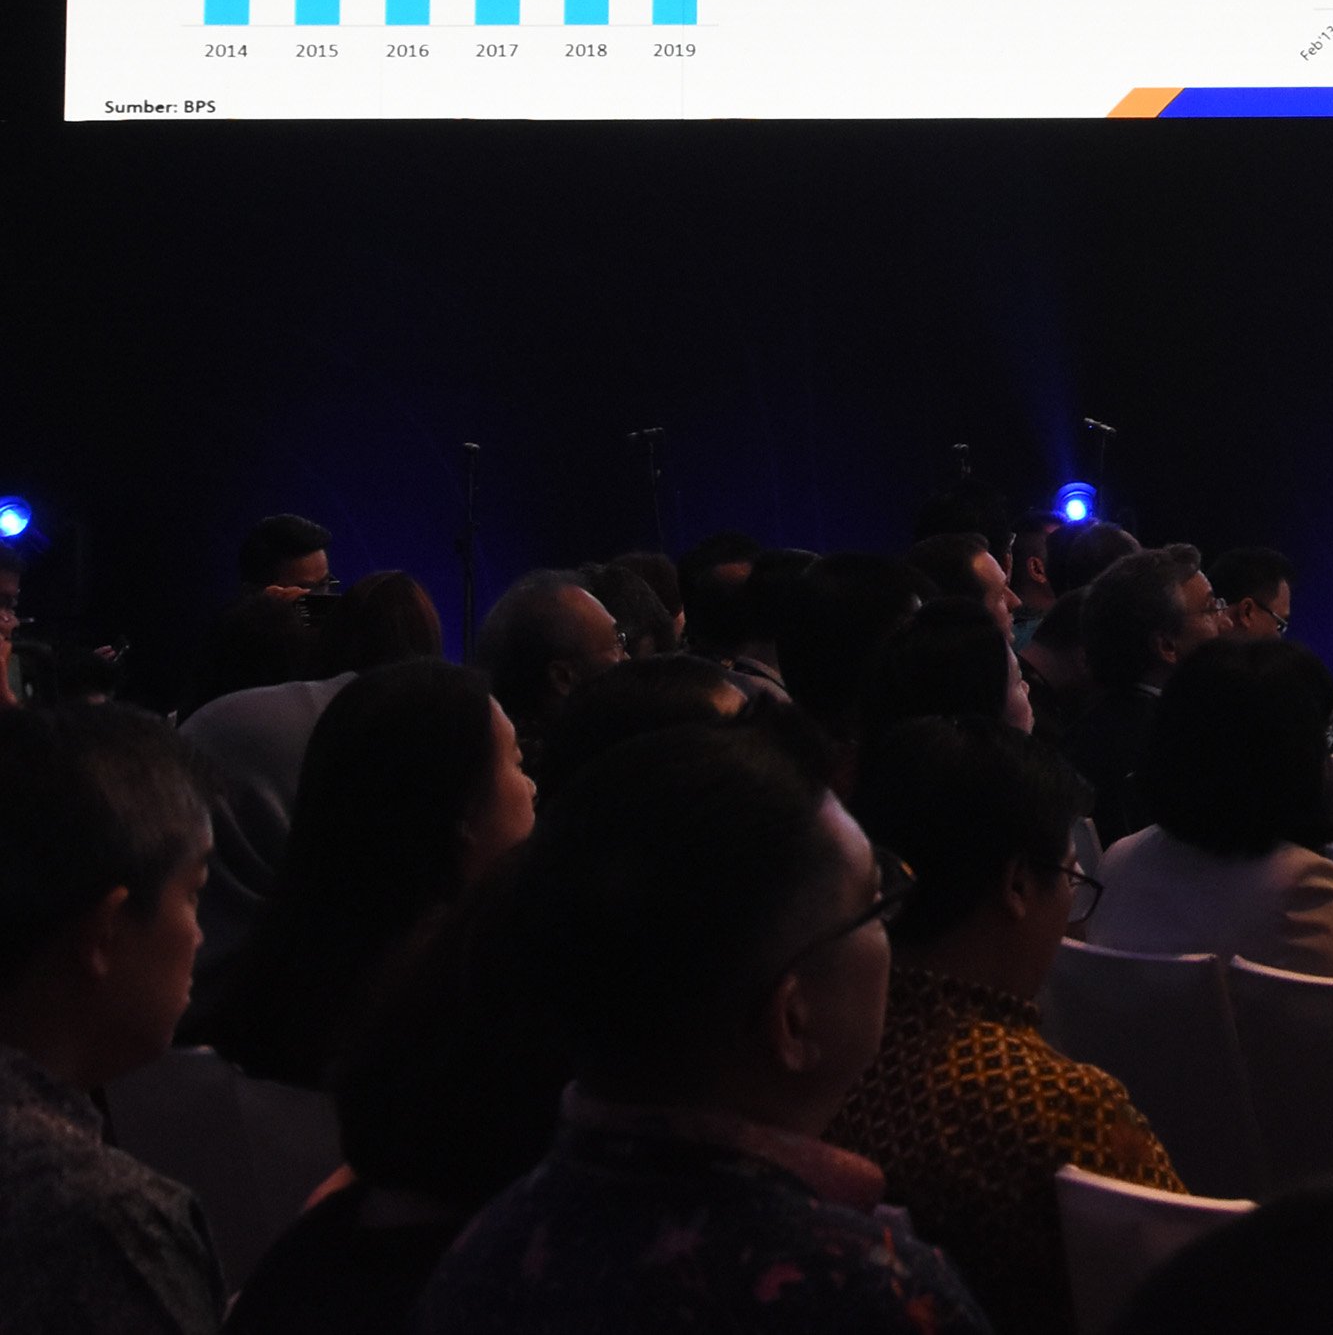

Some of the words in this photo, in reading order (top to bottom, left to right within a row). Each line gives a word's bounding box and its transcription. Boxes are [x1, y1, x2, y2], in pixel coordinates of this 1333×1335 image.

[204, 43, 248, 58] 2014
[653, 43, 697, 58] 2019
[104, 99, 178, 114] Sumber:
[183, 99, 216, 114] BPS
